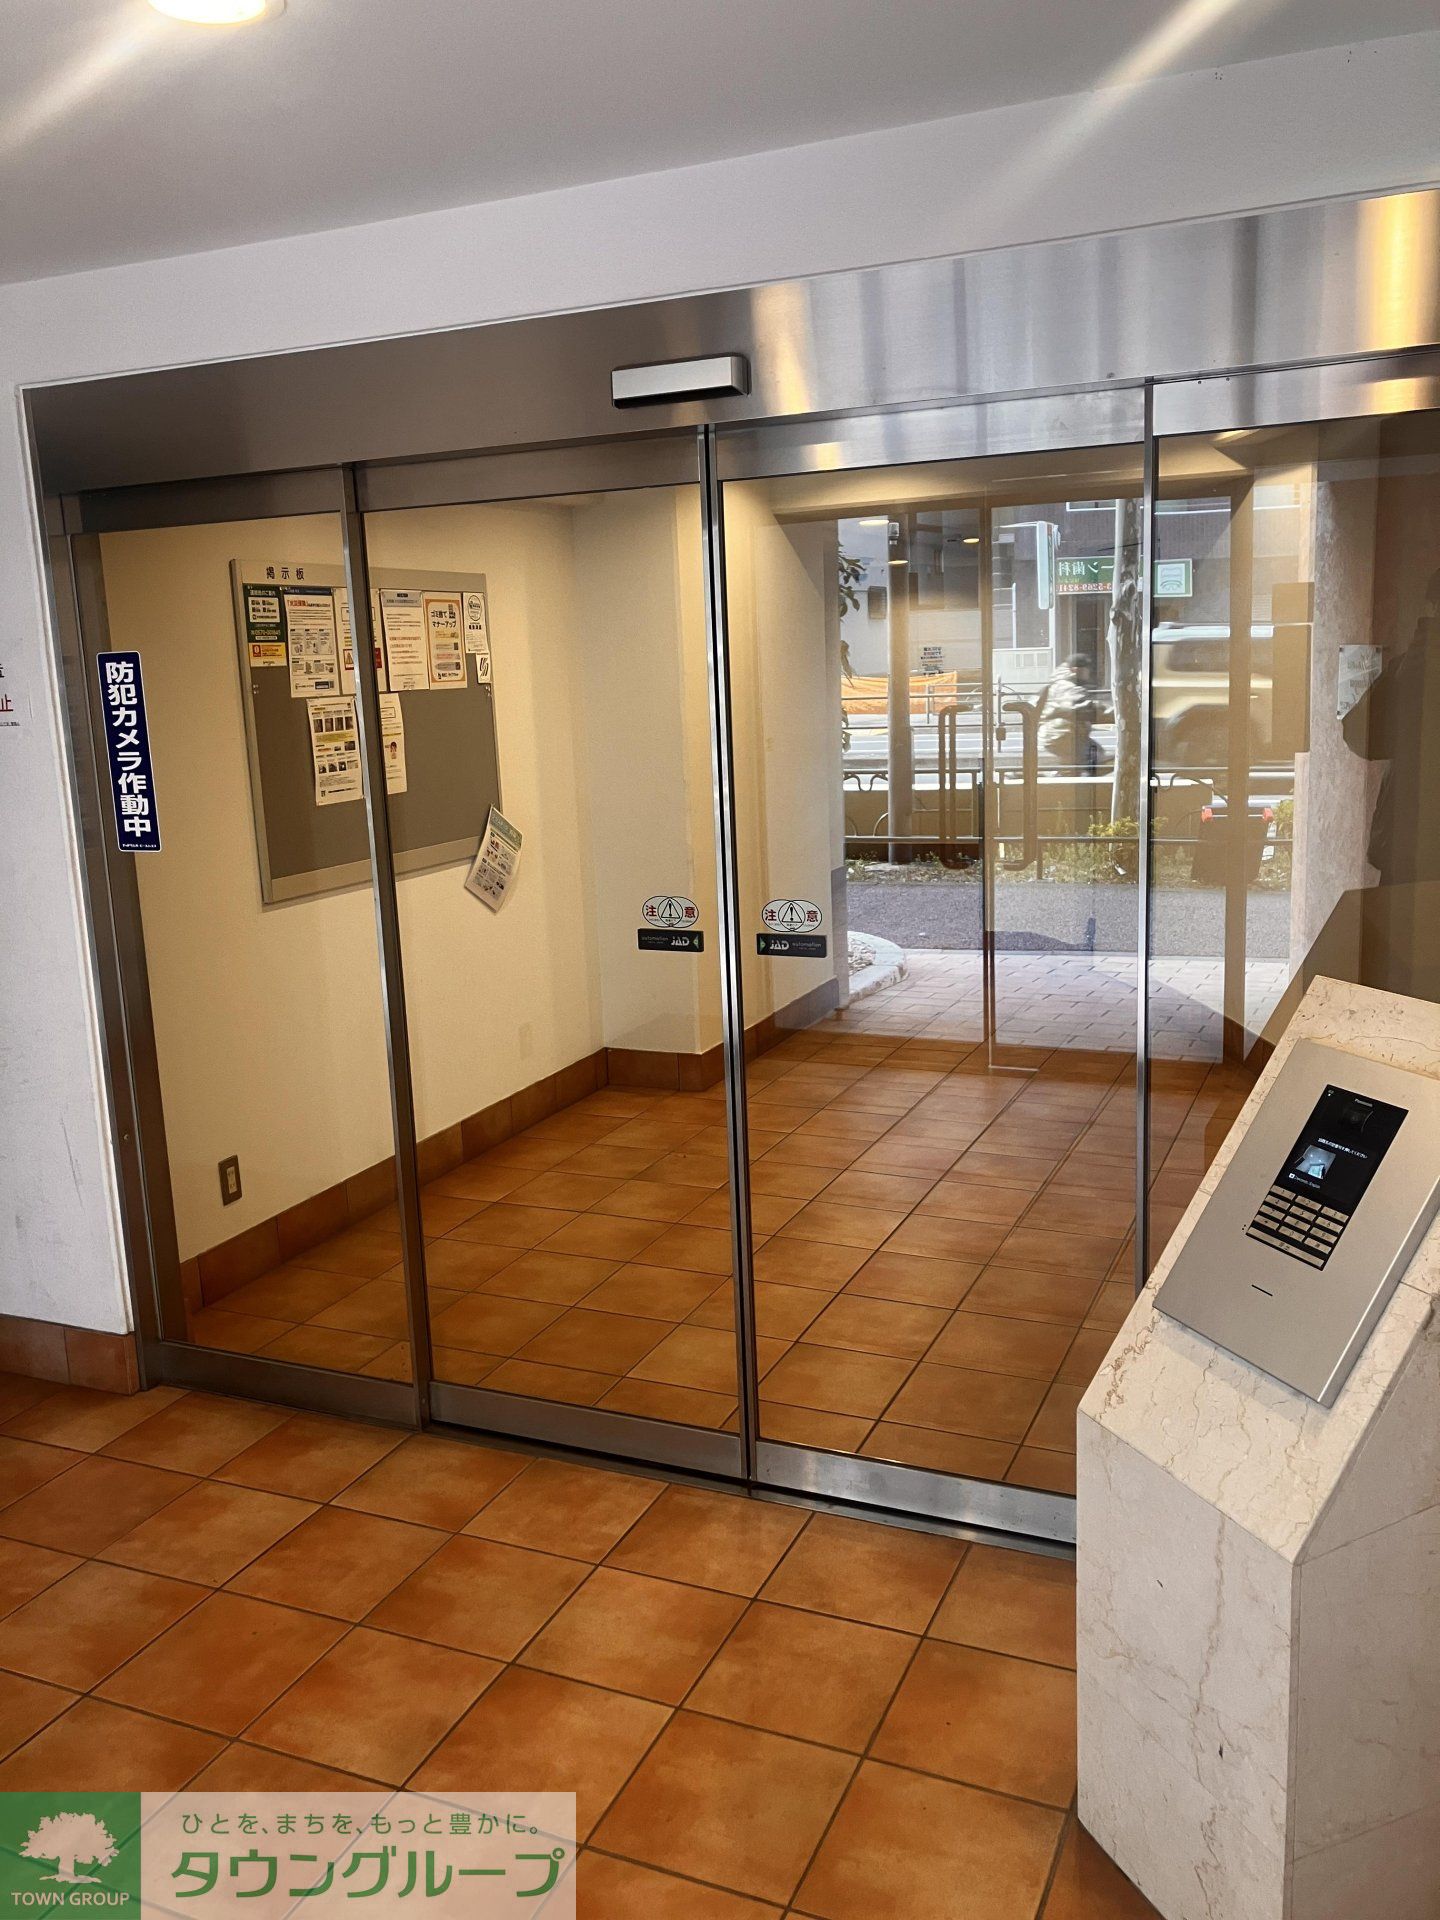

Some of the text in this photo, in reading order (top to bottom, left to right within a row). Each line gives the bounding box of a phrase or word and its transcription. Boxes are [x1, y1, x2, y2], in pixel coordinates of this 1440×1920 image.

[266, 566, 305, 580] 掲示板
[105, 661, 152, 837] 防犯カメラ作動中
[645, 905, 696, 918] 注 意
[764, 908, 819, 922] 注 意
